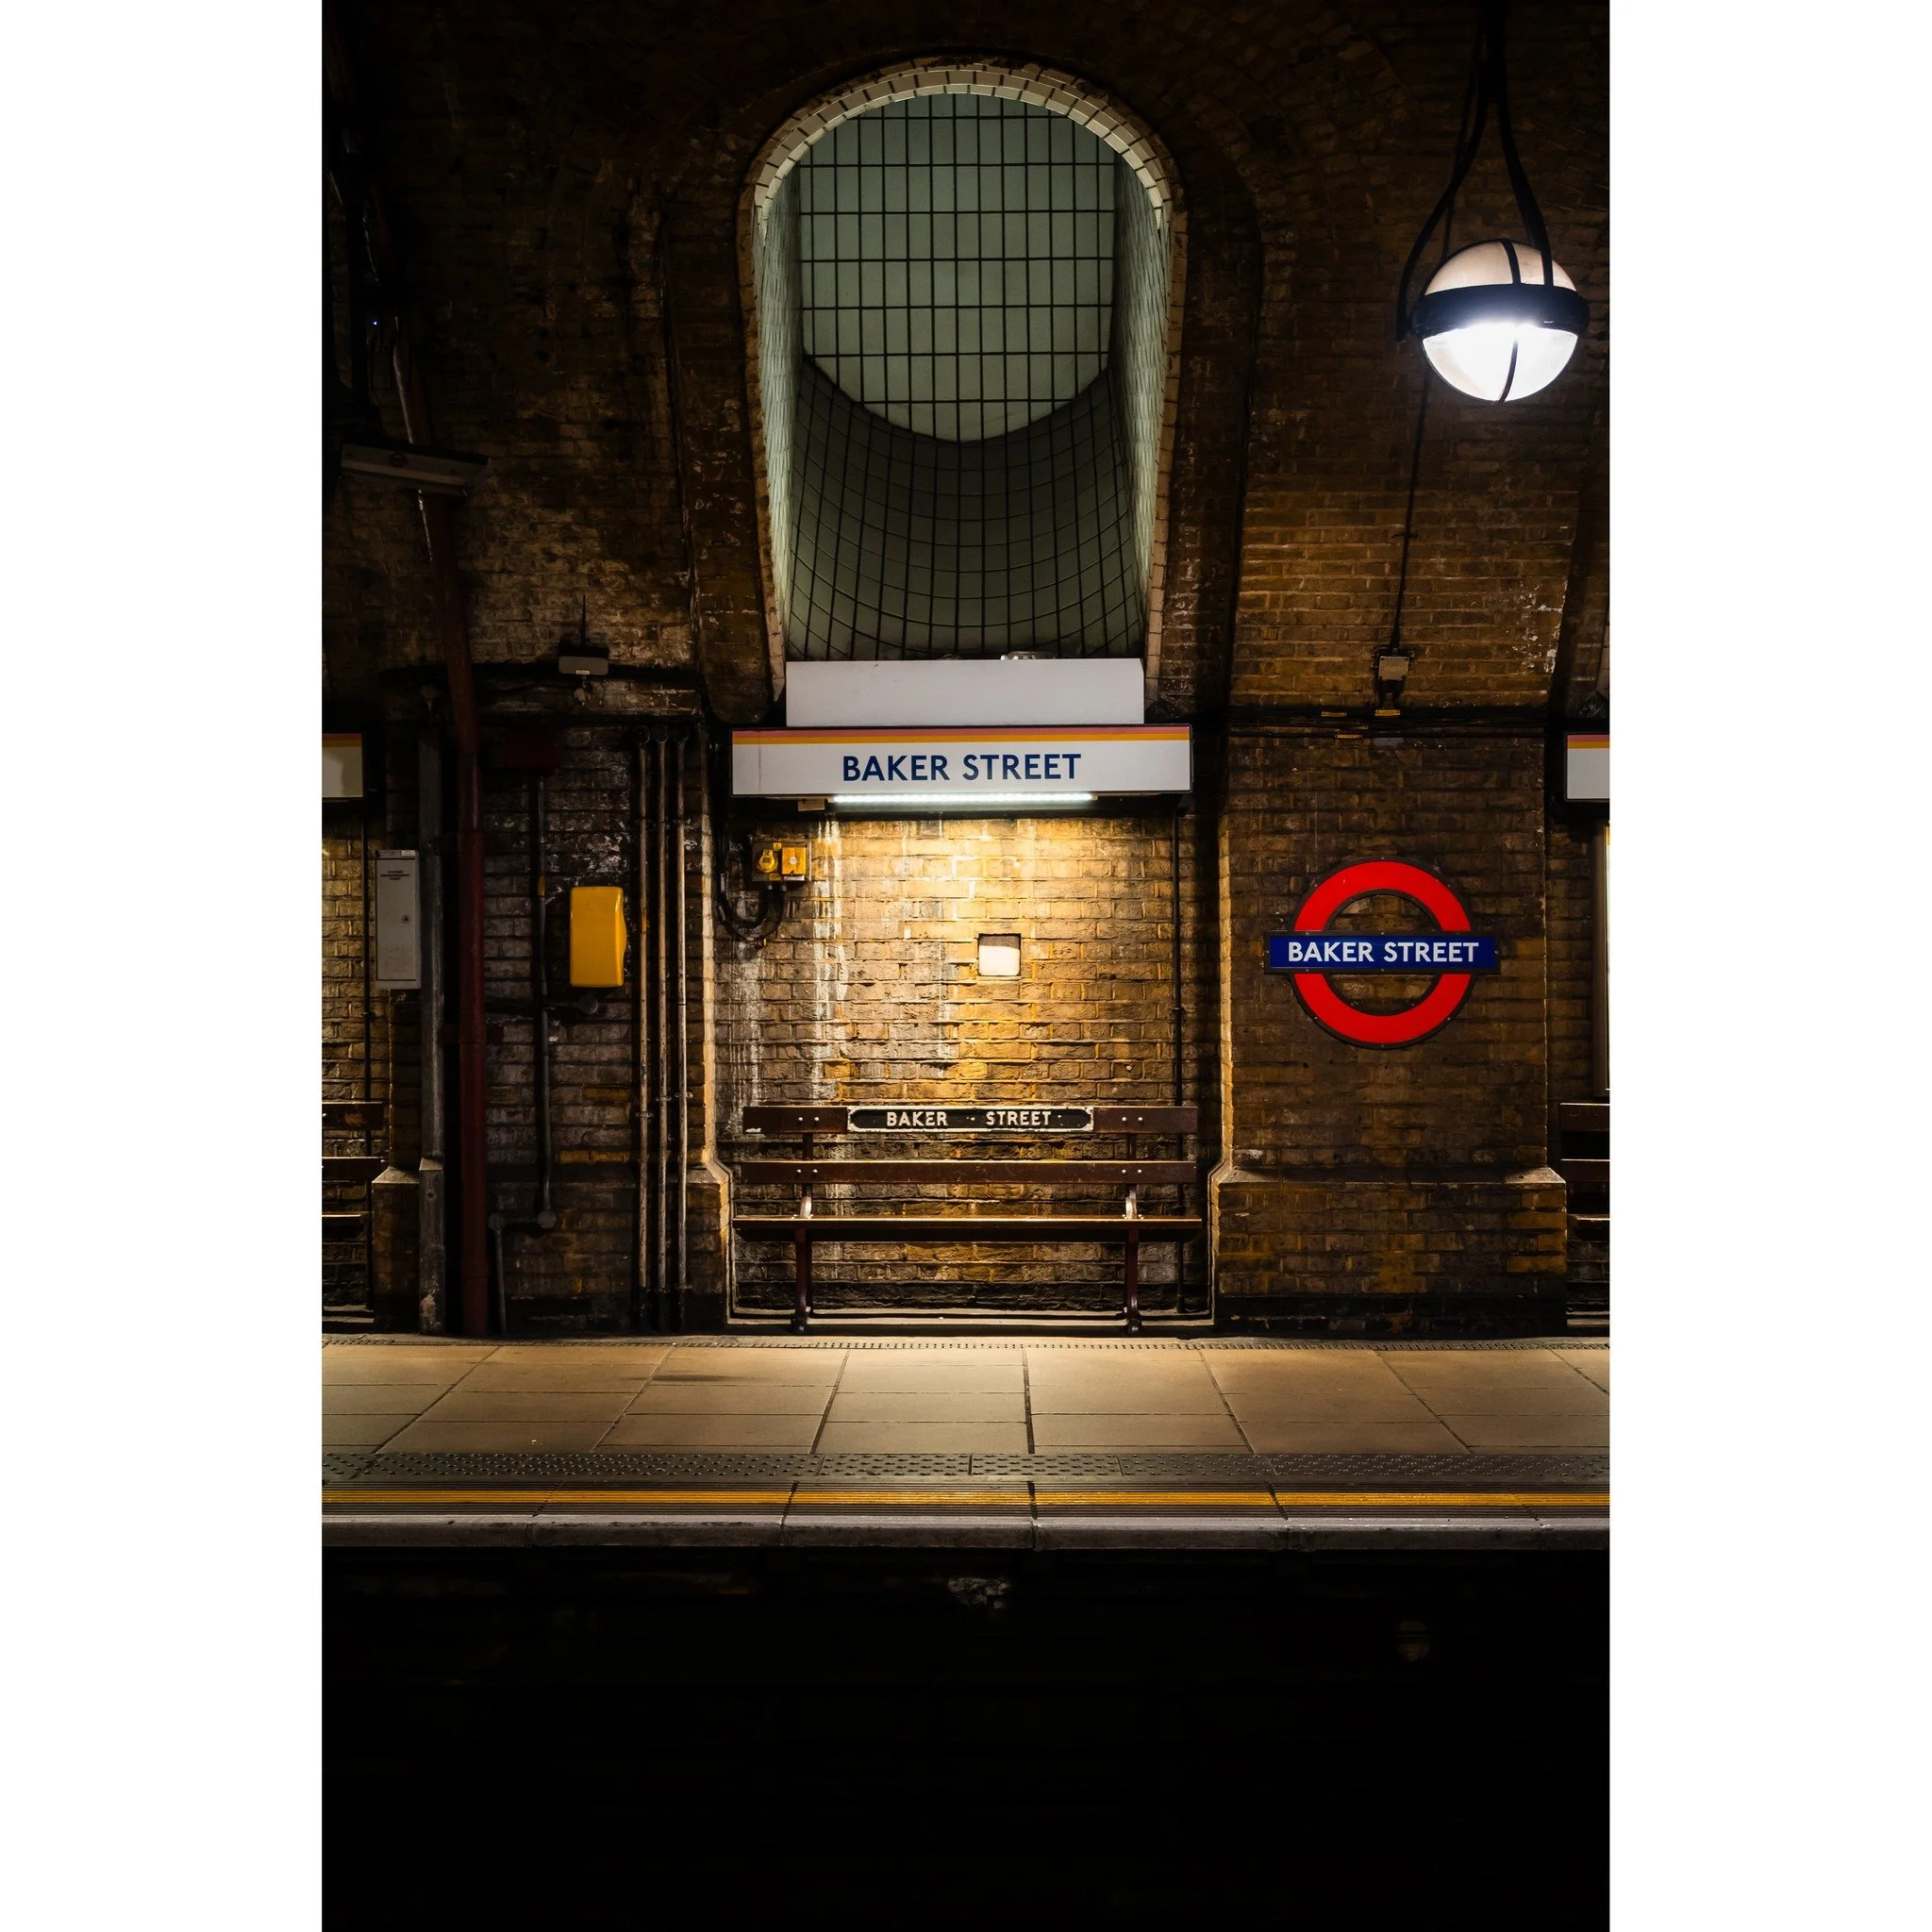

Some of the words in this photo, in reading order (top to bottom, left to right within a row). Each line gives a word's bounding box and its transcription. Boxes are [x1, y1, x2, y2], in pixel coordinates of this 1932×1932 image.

[842, 755, 951, 782] BAKER
[962, 753, 1082, 781] STREET
[1288, 941, 1375, 962] BAKER
[1383, 941, 1480, 962] STREET
[886, 1110, 949, 1127] BAKER
[985, 1110, 1052, 1126] STREET
